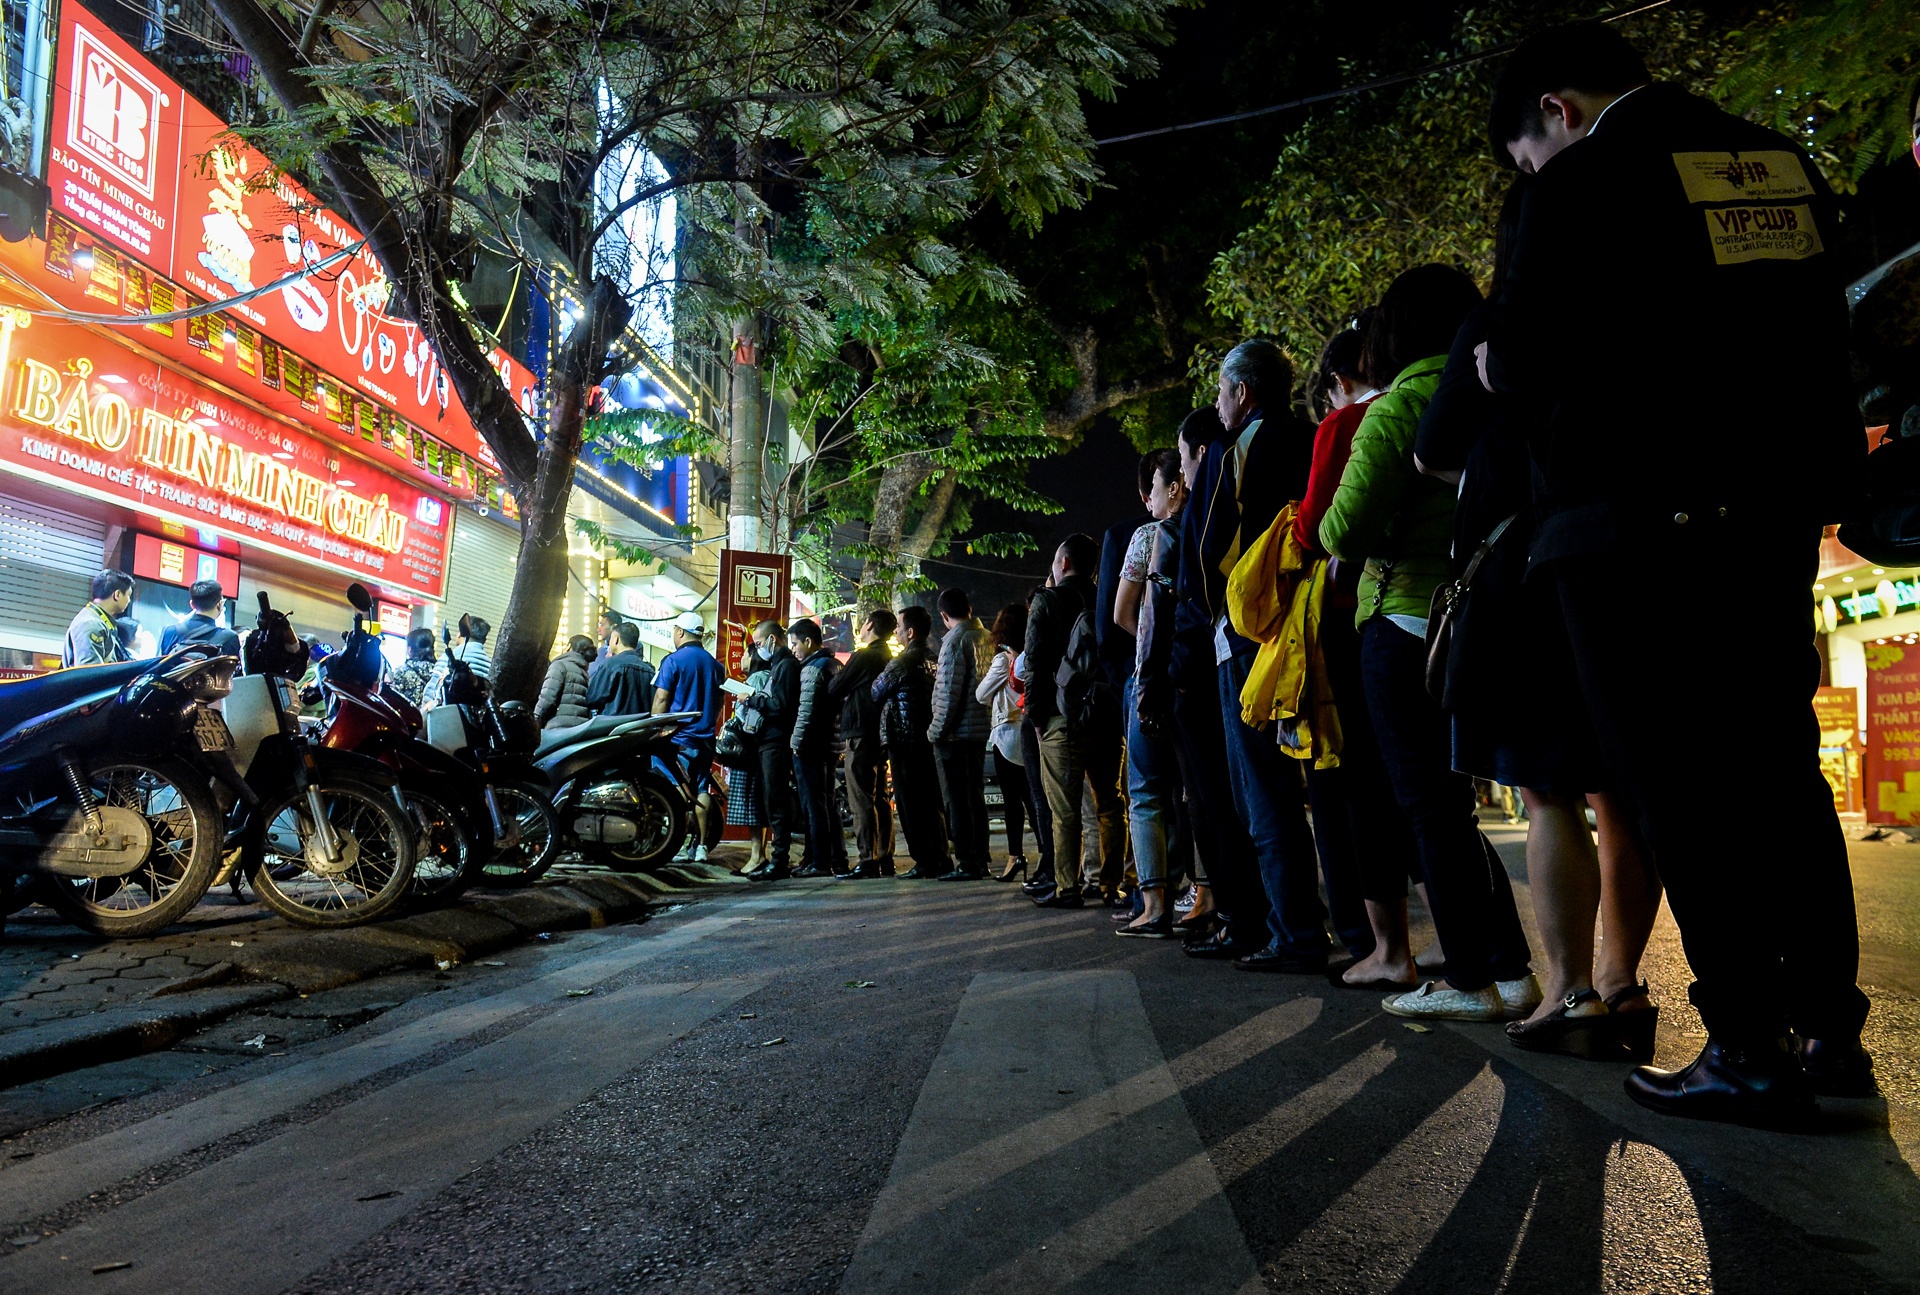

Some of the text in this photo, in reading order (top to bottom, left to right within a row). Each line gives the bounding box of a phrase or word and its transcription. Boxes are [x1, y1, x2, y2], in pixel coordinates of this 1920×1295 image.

[52, 147, 165, 230] BẢO TÍN MINH CHÂU
[1713, 208, 1798, 234] VIP CLUB
[18, 357, 408, 554] BẢO TÍN MINH CHÂU
[21, 437, 58, 462] KINH
[59, 450, 107, 478] DOANH
[107, 464, 134, 487] CHẾ
[159, 483, 196, 508] TRANG
[247, 514, 267, 532] BẠC
[1877, 692, 1903, 706] KIM
